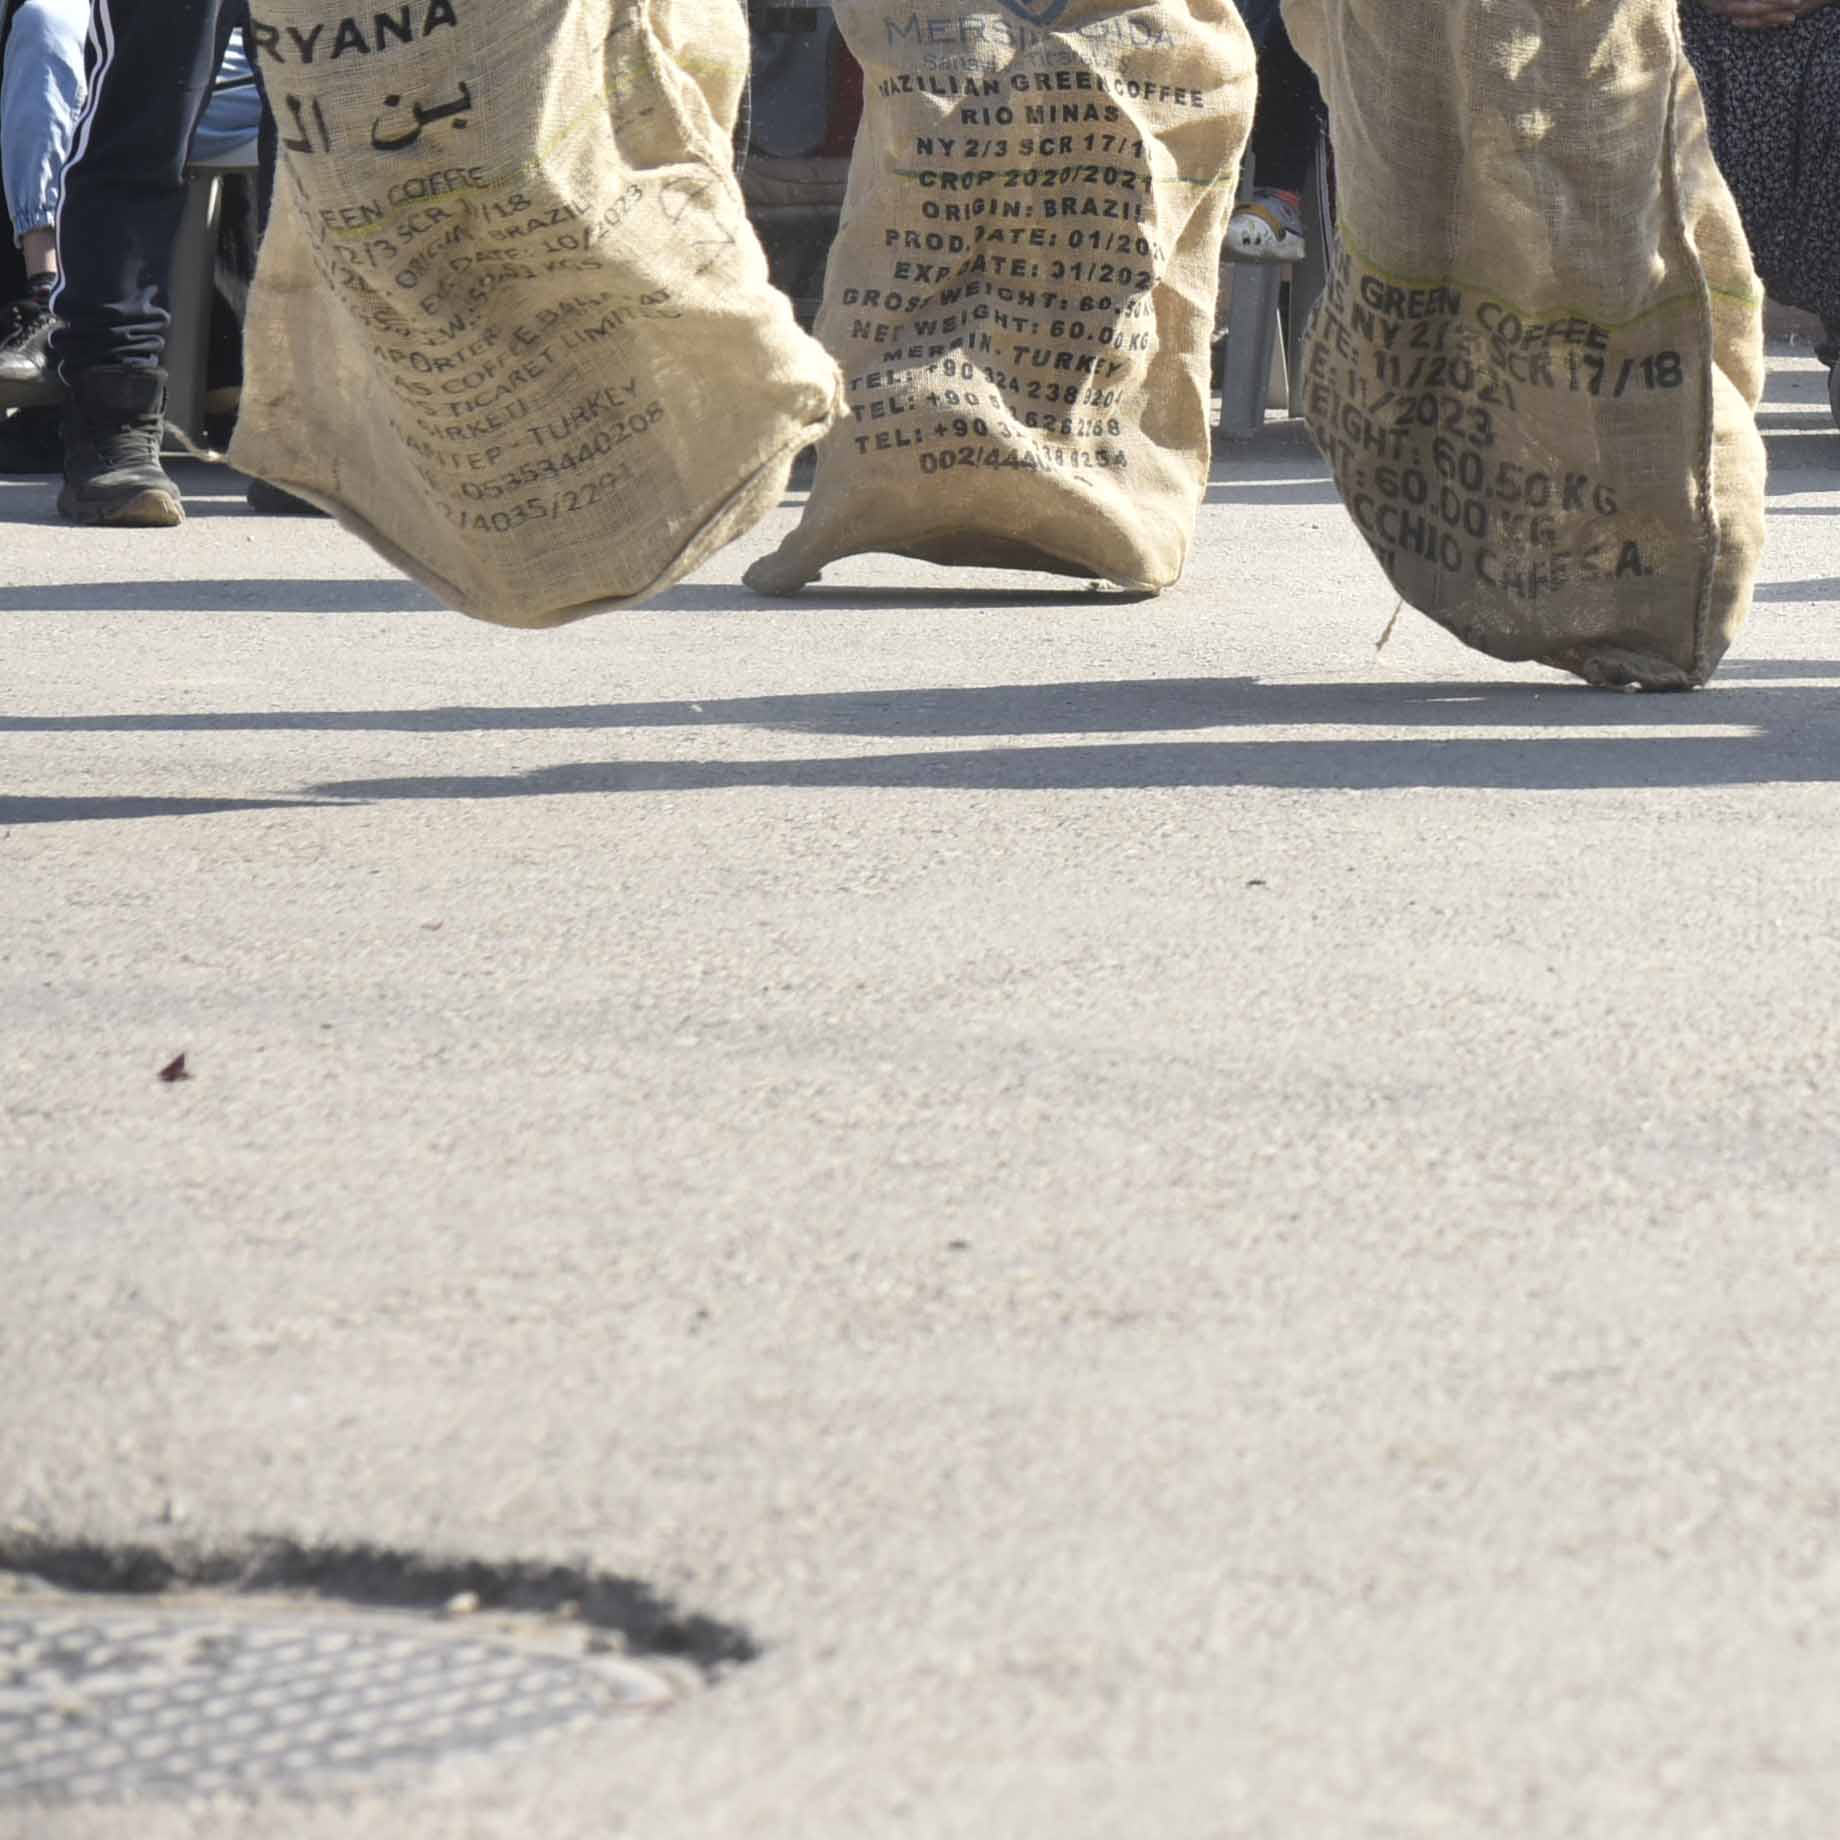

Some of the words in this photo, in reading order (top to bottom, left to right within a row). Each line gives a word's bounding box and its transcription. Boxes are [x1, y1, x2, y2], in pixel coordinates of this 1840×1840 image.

[1113, 79, 1205, 109] COFFEE
[960, 105, 1014, 126] RIO
[1025, 104, 1120, 124] MINAS
[916, 136, 955, 158] NY
[964, 137, 1008, 158] 2/3
[1018, 135, 1073, 155] SCR
[1083, 132, 1151, 159] 17/1
[918, 168, 996, 191] CROP
[921, 197, 1033, 220] ORIGIN:
[884, 228, 971, 254] PROD.
[939, 280, 1069, 310] WEIGHT:
[914, 301, 1040, 335] WEIGHT:
[1360, 273, 1462, 321] GREEN
[1477, 301, 1610, 351] COFFEE
[1013, 345, 1121, 379] TURKEY
[1351, 302, 1401, 351] NY
[1563, 349, 1684, 399] 17/18
[1028, 381, 1078, 405] 238
[527, 377, 639, 448] TURKEY
[853, 396, 915, 423] TEL:
[855, 428, 923, 455] TEL:
[933, 417, 988, 438] +90
